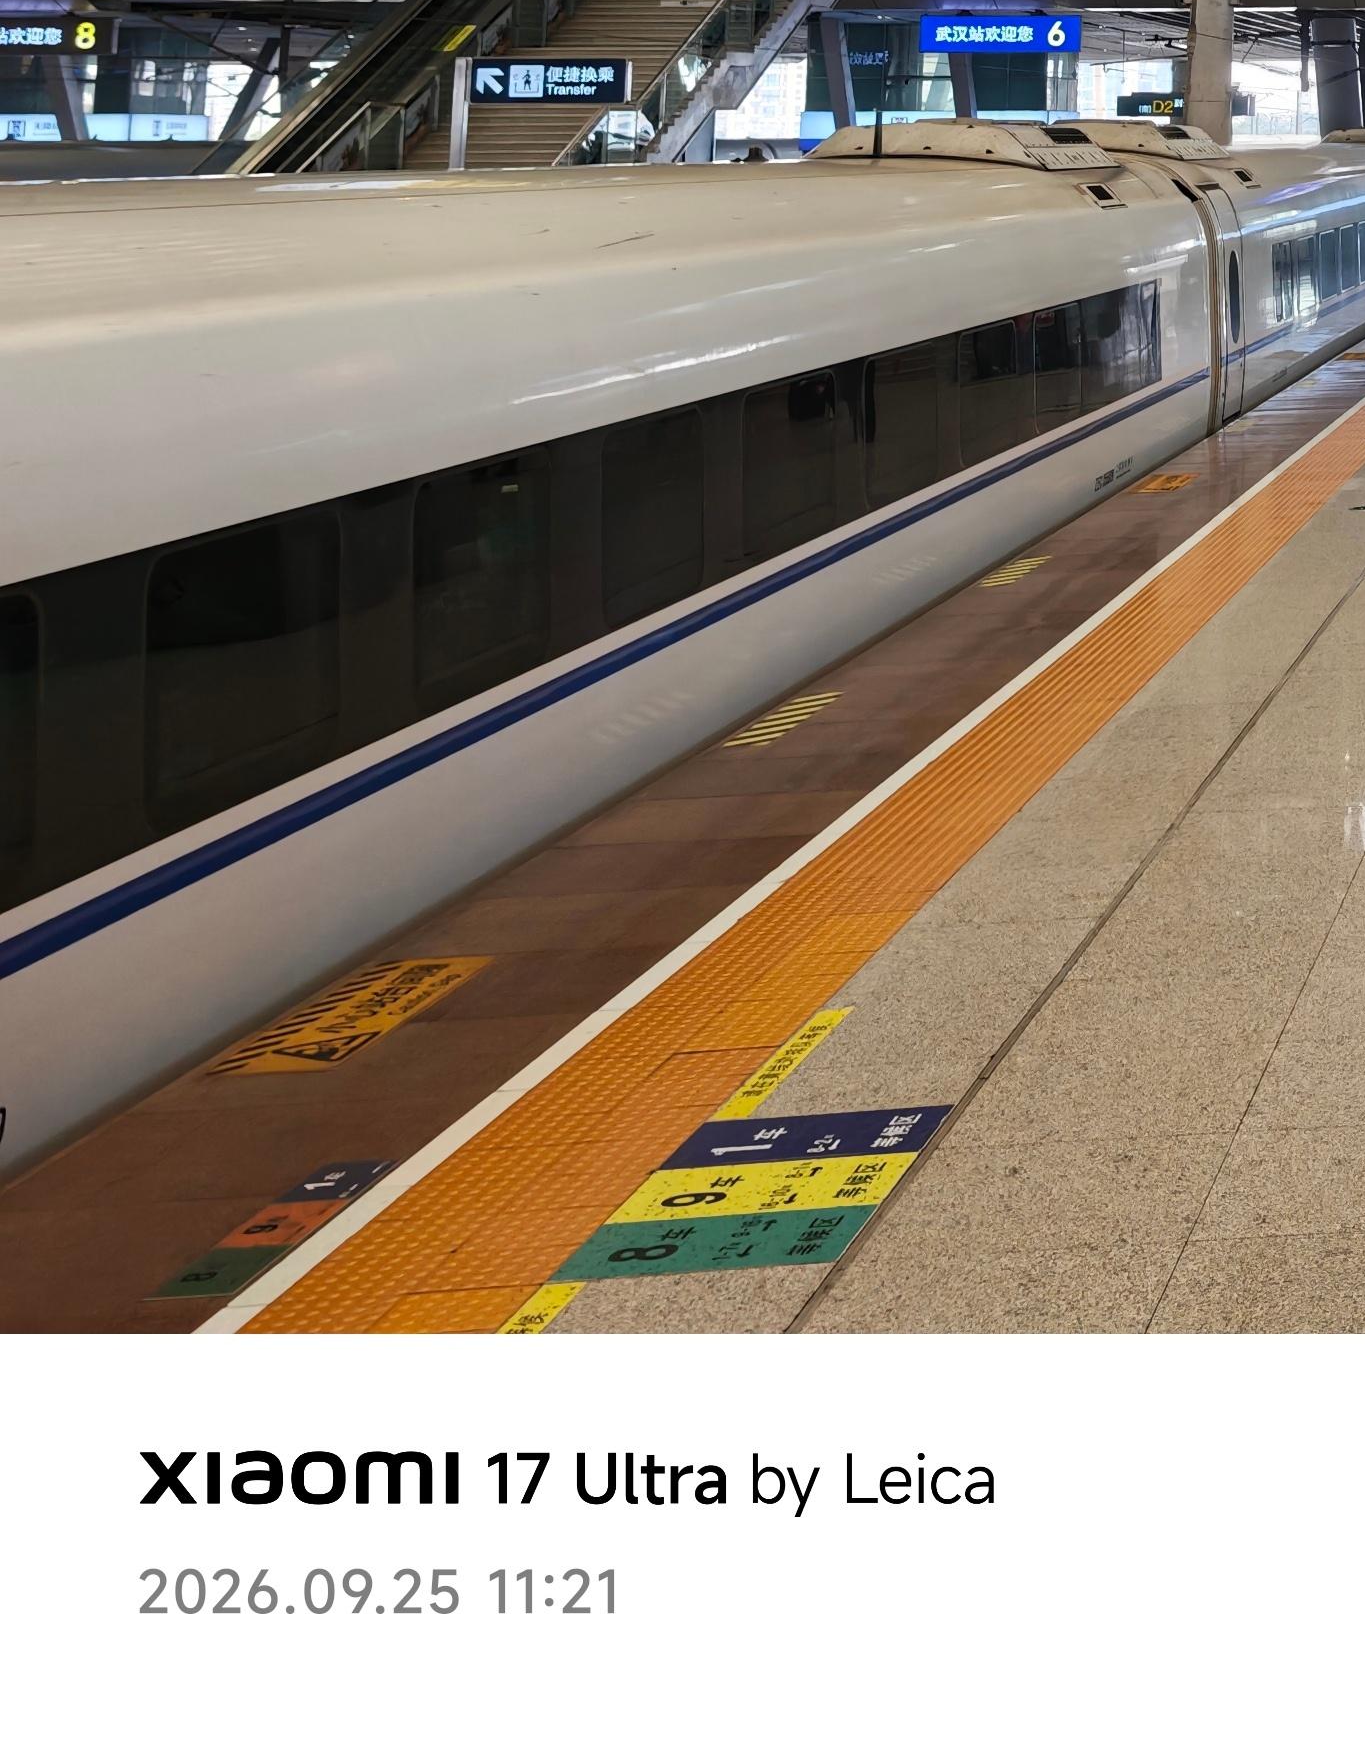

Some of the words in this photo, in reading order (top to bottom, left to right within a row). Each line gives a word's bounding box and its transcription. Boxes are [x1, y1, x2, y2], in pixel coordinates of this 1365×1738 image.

[74, 21, 96, 49] 8
[935, 26, 1034, 43] 武汉站欢迎您
[1047, 20, 1065, 47] 6
[546, 66, 615, 83] 便捷换乘
[546, 84, 597, 96] Transfer
[1153, 100, 1173, 113] D2
